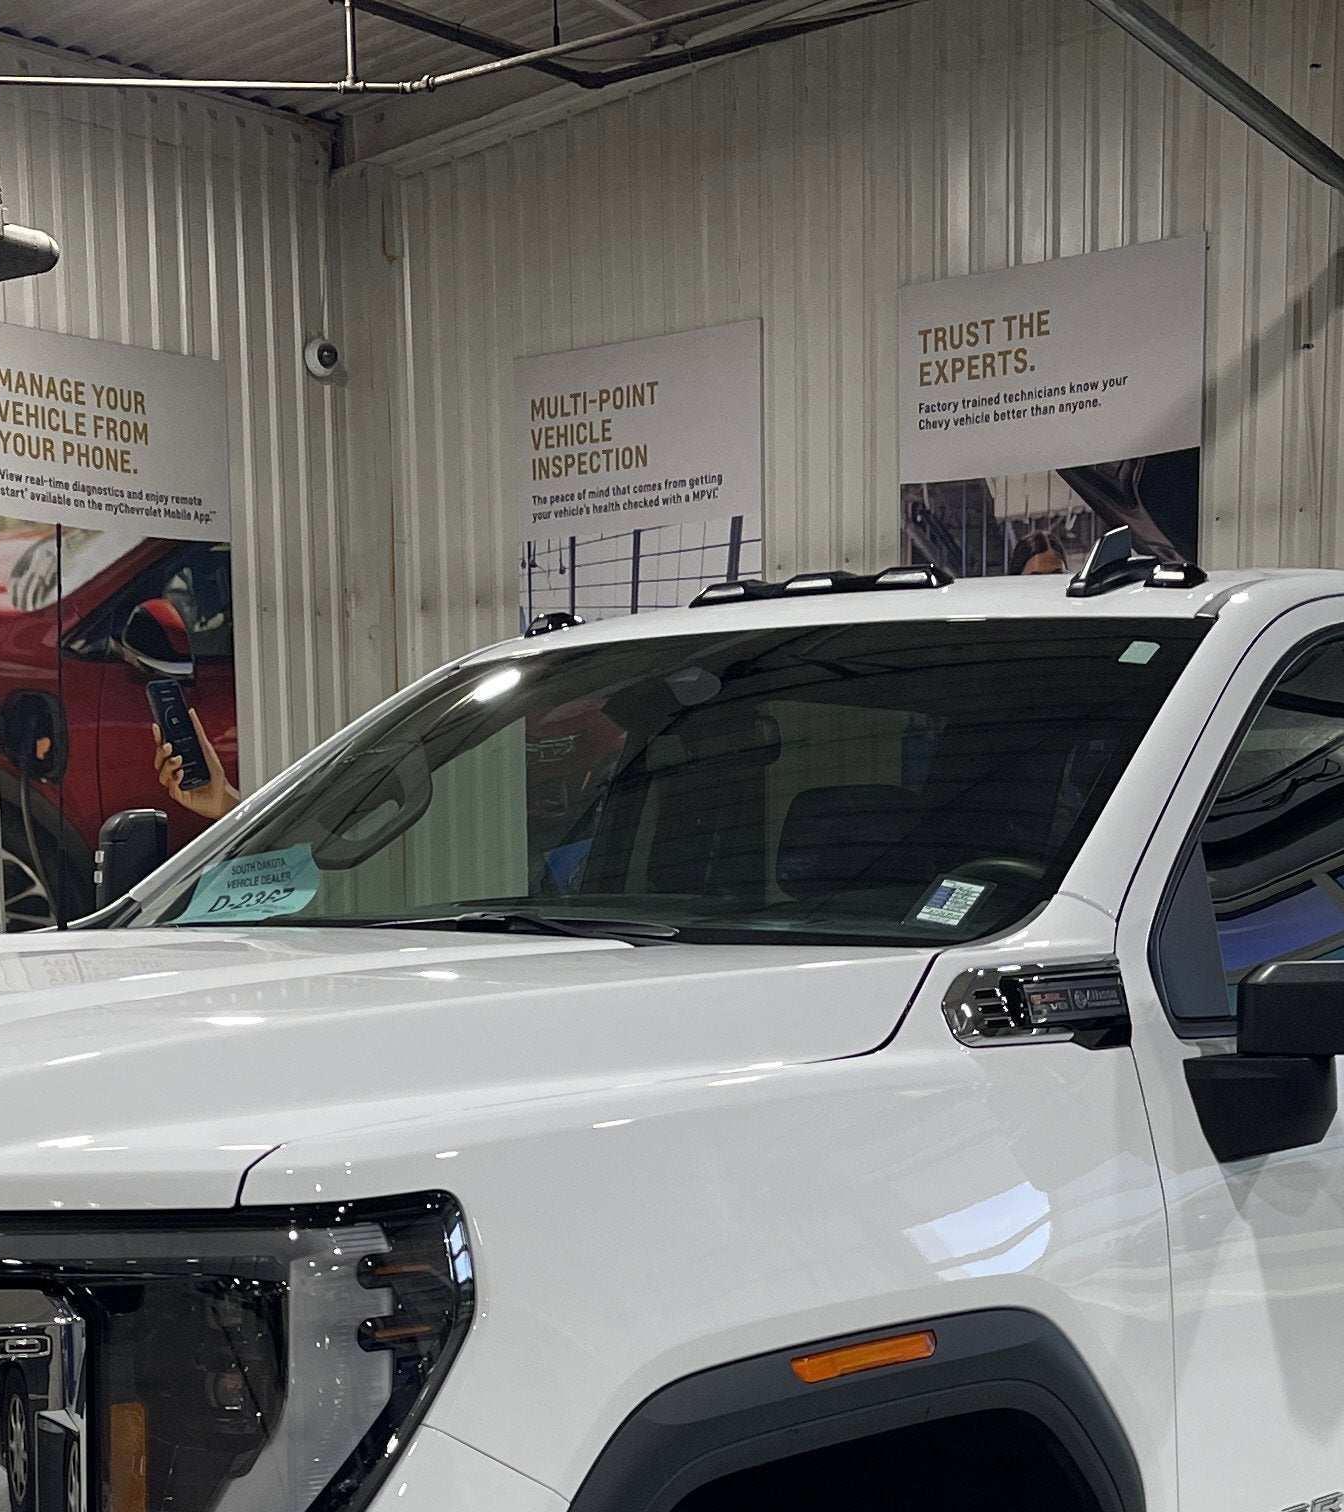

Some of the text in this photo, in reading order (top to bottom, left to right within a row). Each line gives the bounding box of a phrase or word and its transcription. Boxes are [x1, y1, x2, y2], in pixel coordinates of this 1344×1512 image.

[918, 309, 1050, 354] TRUST THE
[919, 348, 1036, 387] EXPERTS.
[91, 384, 146, 415] YOUR
[530, 381, 658, 422] MULTI-POINT
[918, 375, 1129, 415] Factory trained technicians know your
[94, 415, 149, 446] FROM
[918, 397, 1102, 431] Chevy vehicle better than anyone.
[530, 418, 612, 450] VEHICLE
[62, 440, 138, 474] PHONE.
[532, 444, 648, 480] INSPECTION
[25, 473, 70, 491] real-time
[72, 481, 125, 499] diagnostics
[127, 490, 143, 500] and
[145, 491, 169, 505] enjoy
[171, 495, 203, 506] remote
[30, 490, 72, 507] available
[74, 498, 85, 508] on
[87, 500, 103, 511] the
[105, 502, 162, 518] myChevrolet
[163, 507, 191, 521] Mobile
[532, 473, 723, 506] The peace of mind that comes from getting
[532, 508, 553, 523] your
[553, 503, 590, 519] vehicle's
[592, 499, 621, 514] health
[623, 493, 660, 510] checked
[662, 489, 682, 504] with
[685, 492, 690, 502] a
[226, 871, 292, 889] VEHICLE DEALER
[231, 858, 287, 876] SOUTH DAKOTA
